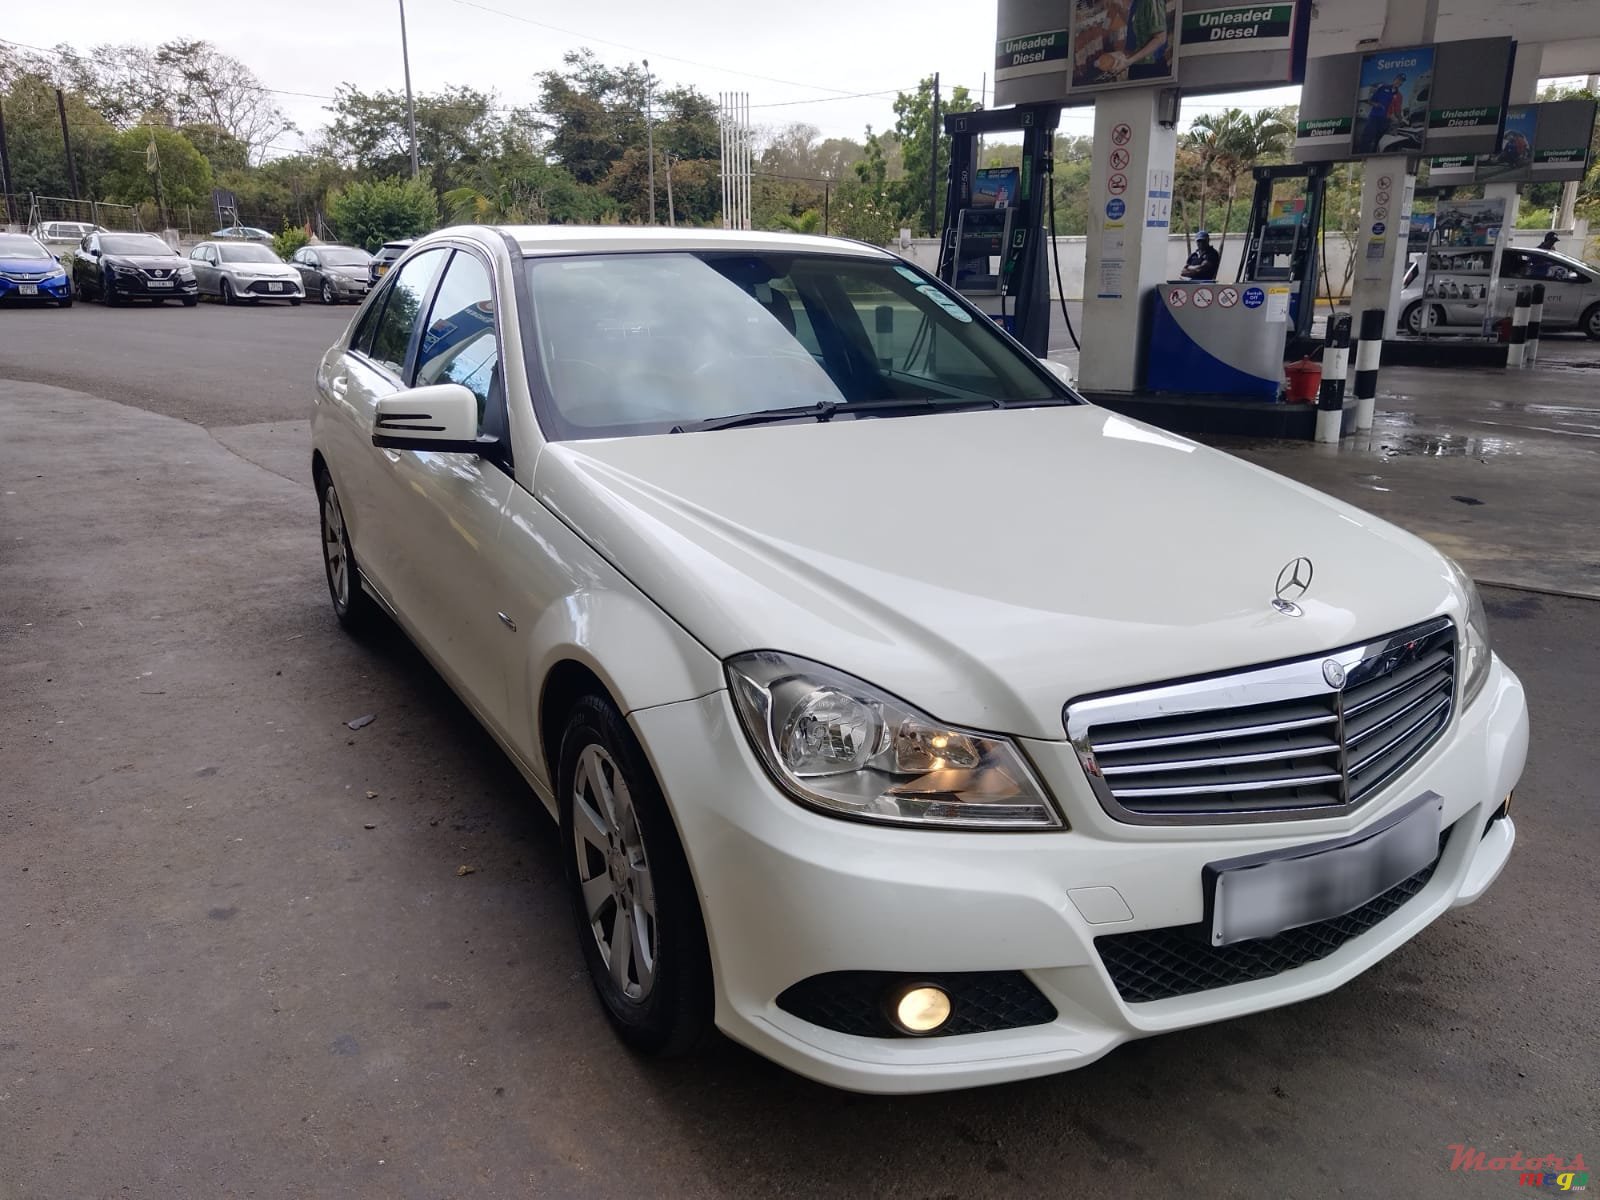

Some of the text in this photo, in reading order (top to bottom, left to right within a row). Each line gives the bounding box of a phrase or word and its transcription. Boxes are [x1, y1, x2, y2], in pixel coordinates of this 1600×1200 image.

[1198, 9, 1272, 27] Unleaded
[1210, 25, 1258, 40] Diesel
[1005, 35, 1055, 53] Unleaded
[1012, 50, 1045, 65] Diesel
[1377, 57, 1417, 71] Service
[1023, 114, 1031, 124] 2
[1441, 107, 1487, 119] Unleaded
[1306, 119, 1343, 130] Unleaded
[1448, 117, 1479, 128] Diesel
[1310, 127, 1336, 137] Diesel
